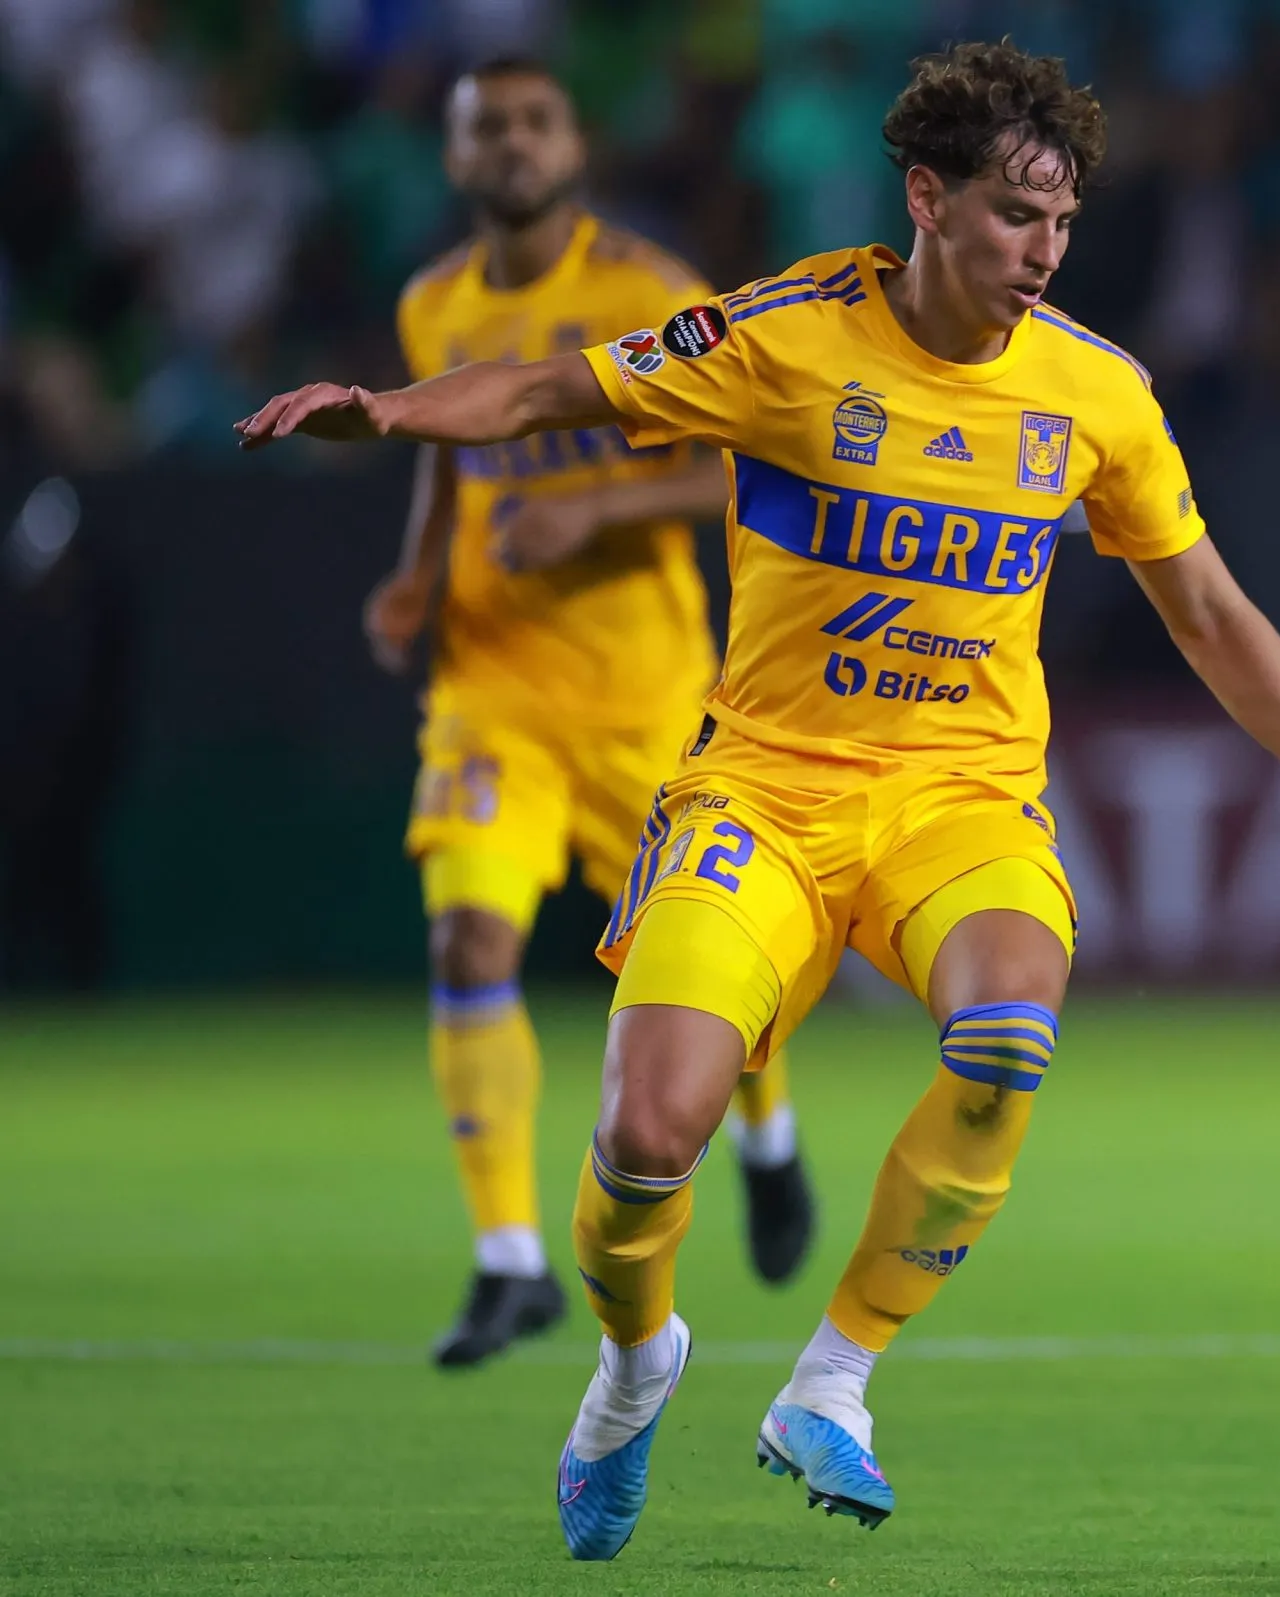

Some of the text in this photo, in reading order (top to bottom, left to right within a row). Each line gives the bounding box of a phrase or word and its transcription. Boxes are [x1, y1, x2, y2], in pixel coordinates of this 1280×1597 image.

[675, 315, 701, 356] CHAMPIONS
[696, 311, 717, 343] Scotiabank
[834, 411, 886, 431] MONTERREY
[1026, 417, 1067, 433] TIGRES
[836, 446, 873, 461] EXTRA
[923, 446, 974, 462] adidas
[1028, 474, 1052, 486] UANL
[808, 486, 1052, 587] TIGRES
[883, 626, 996, 660] CEMEX
[874, 669, 970, 704] Bitso
